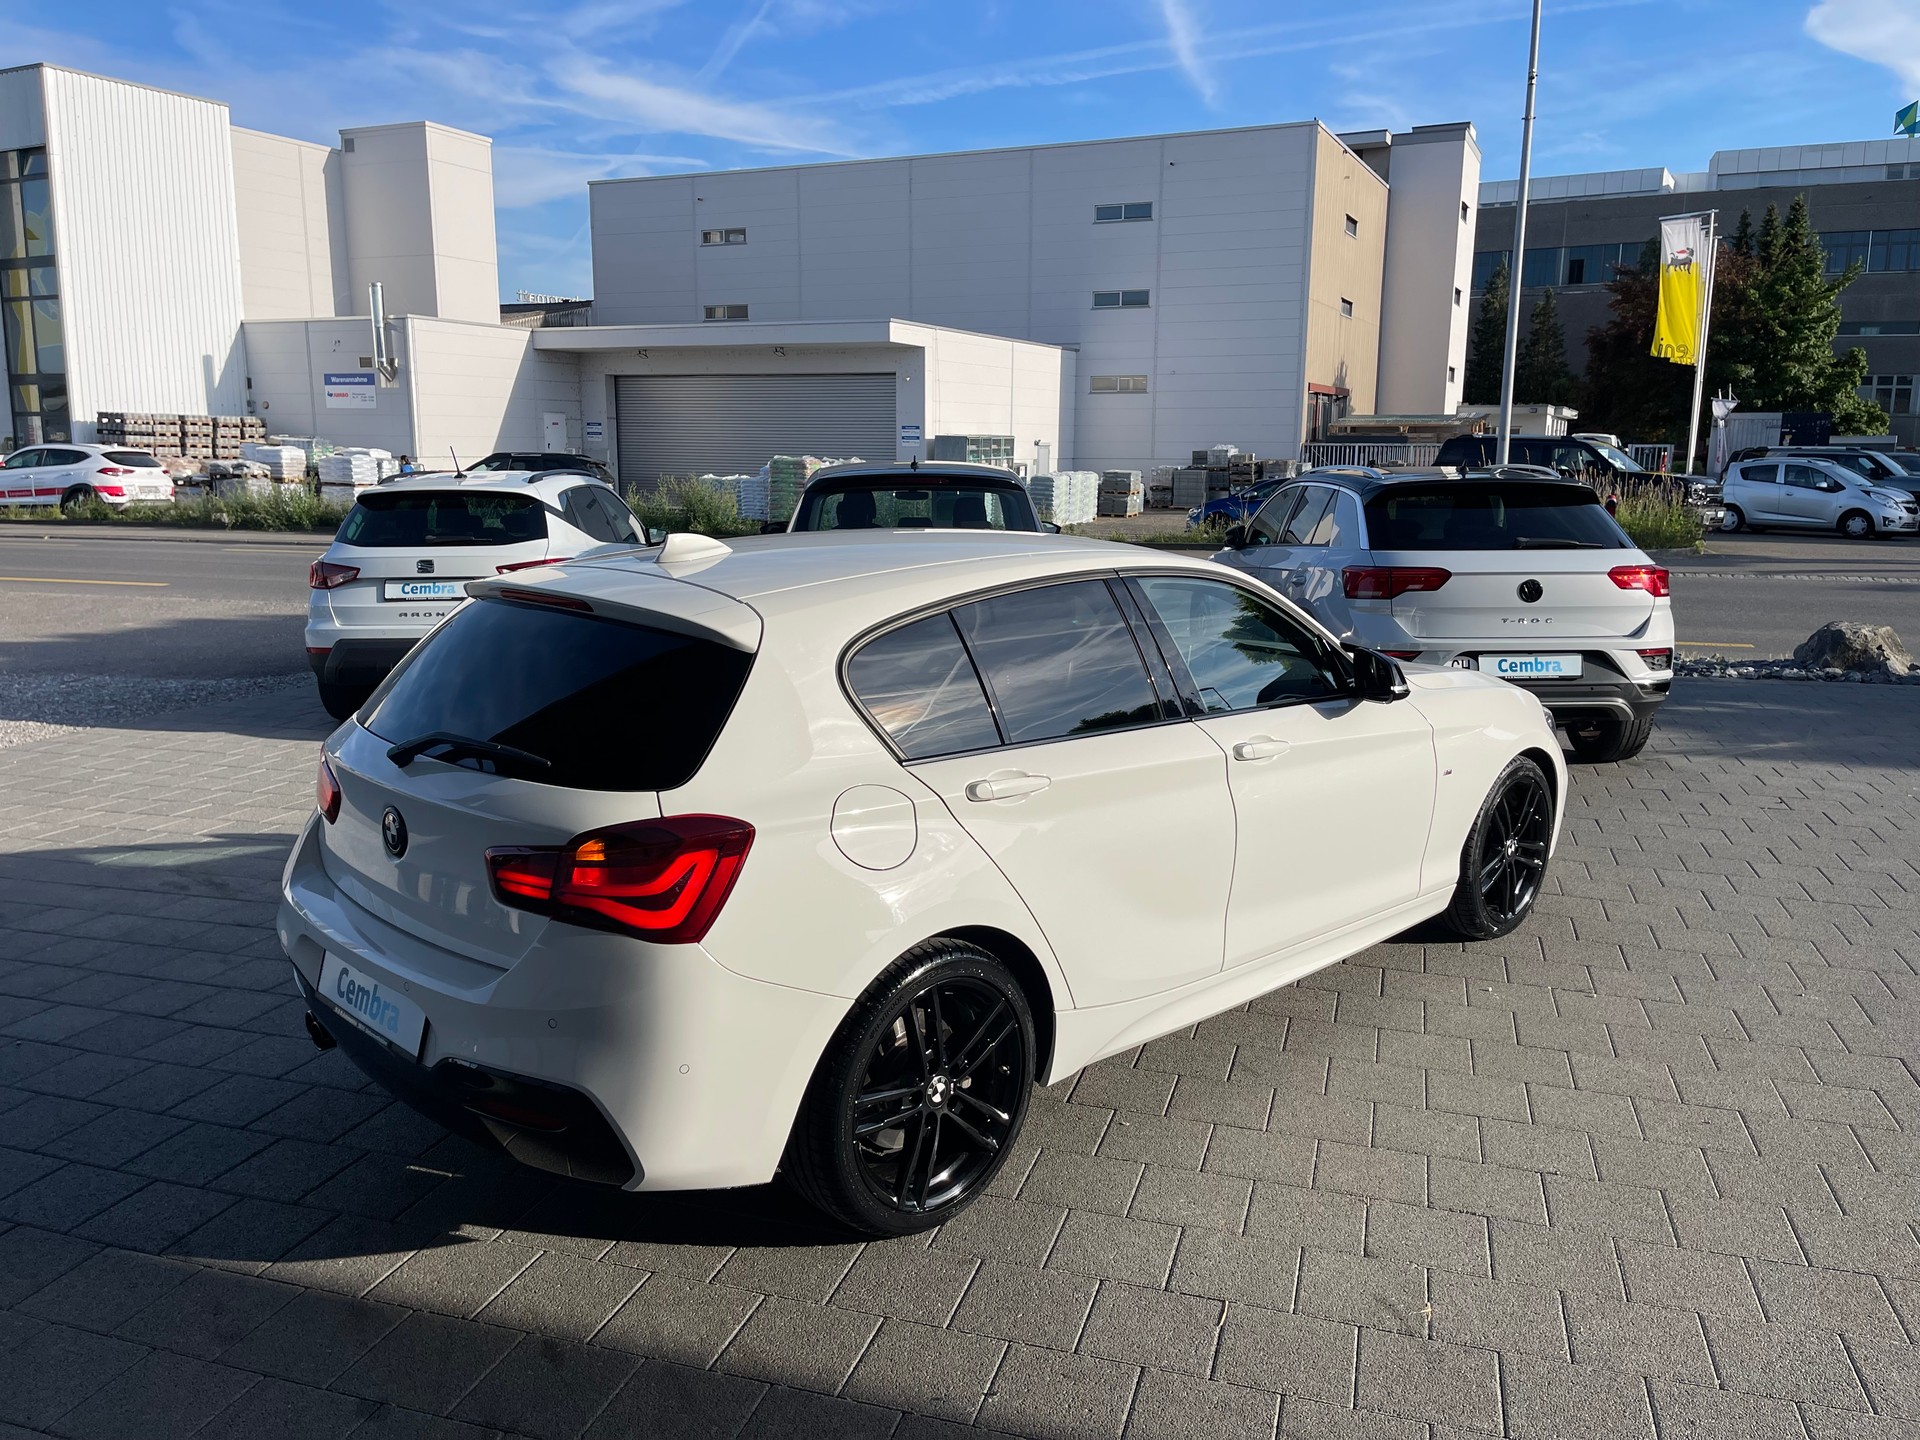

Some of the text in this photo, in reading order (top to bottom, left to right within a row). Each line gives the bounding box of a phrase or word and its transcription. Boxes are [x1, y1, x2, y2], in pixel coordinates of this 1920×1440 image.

[401, 582, 455, 595] Cembra
[1497, 657, 1562, 673] Cembra
[337, 967, 400, 1034] Cembra
